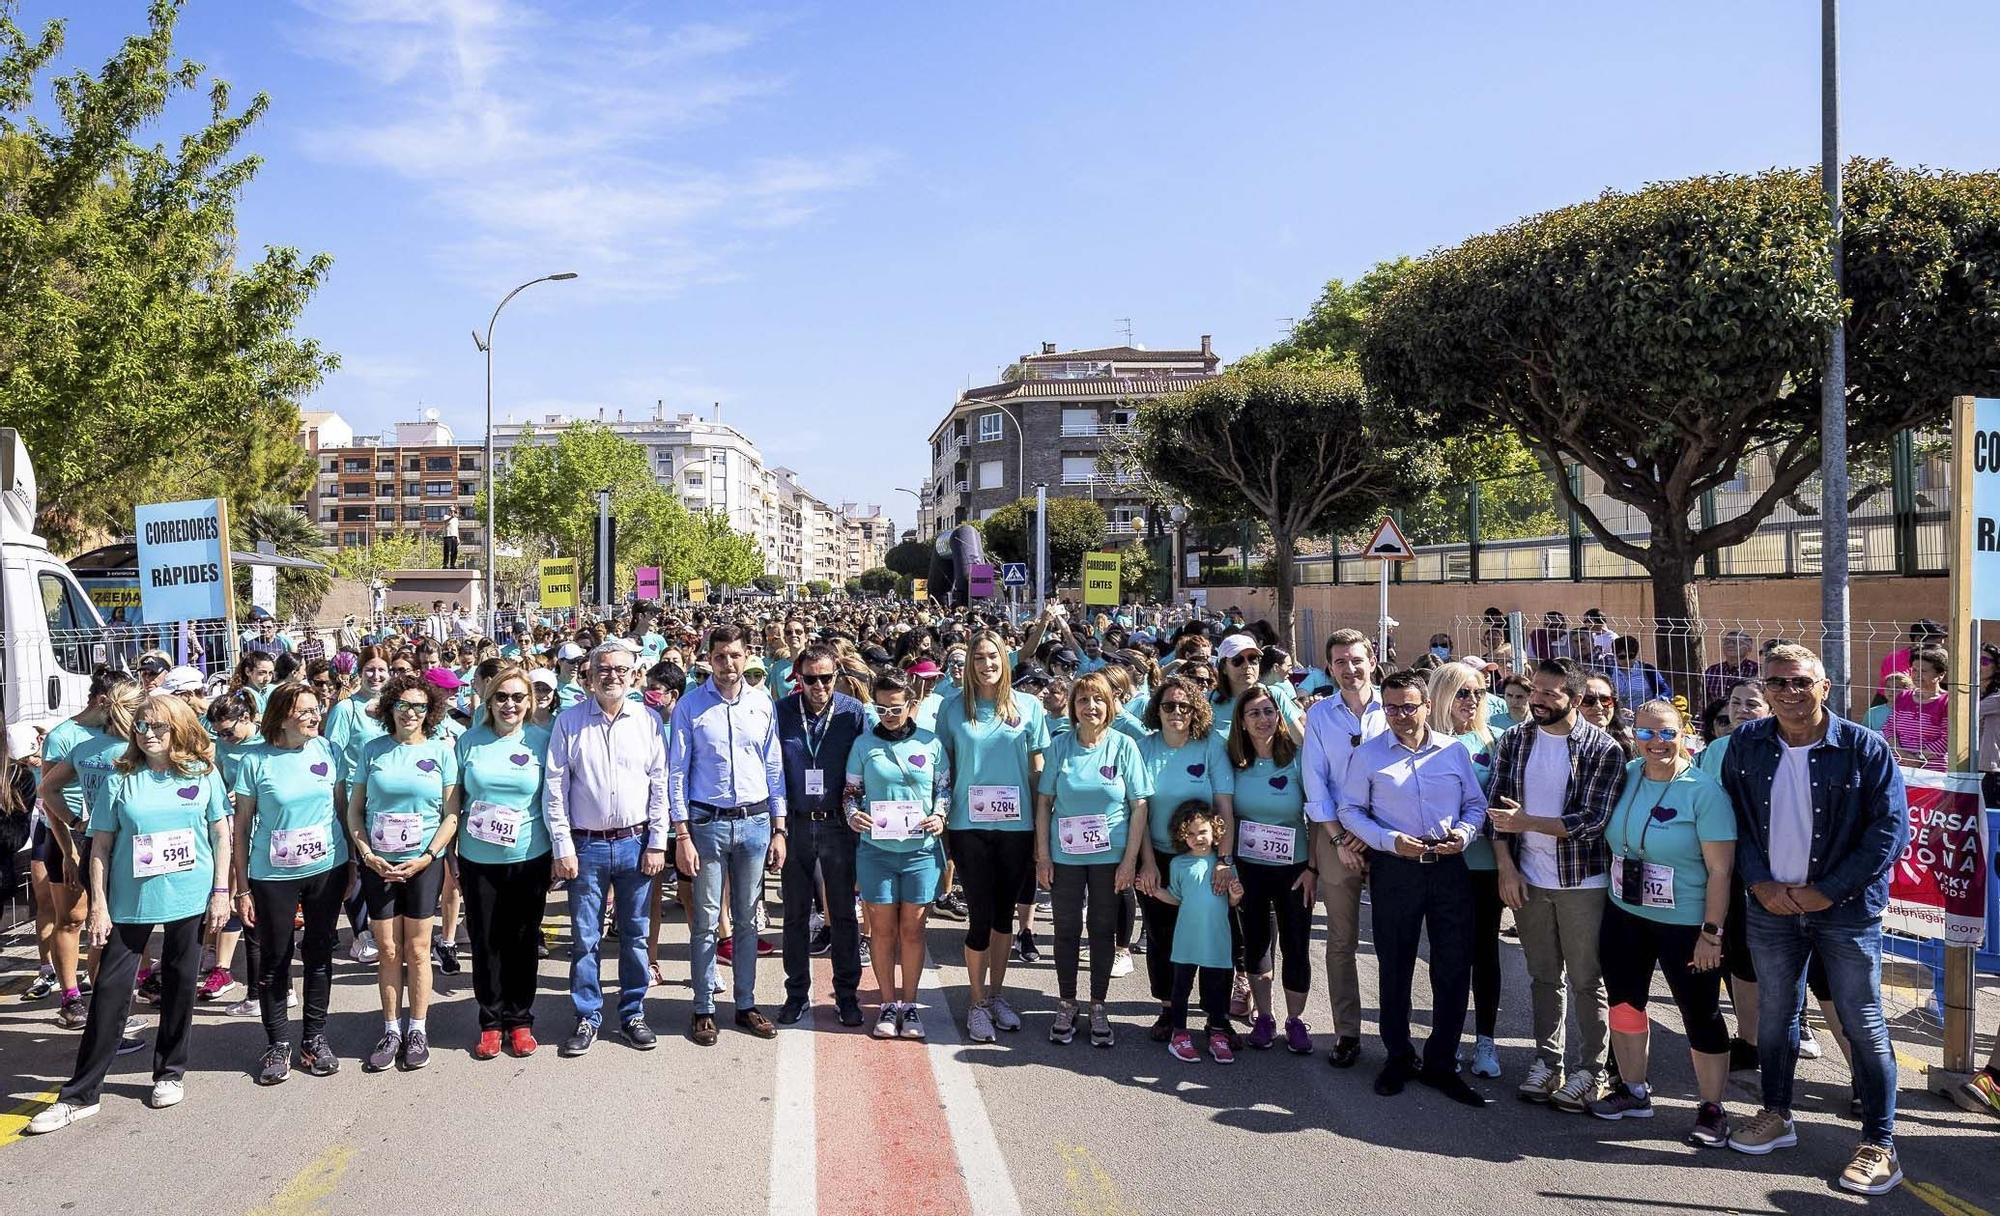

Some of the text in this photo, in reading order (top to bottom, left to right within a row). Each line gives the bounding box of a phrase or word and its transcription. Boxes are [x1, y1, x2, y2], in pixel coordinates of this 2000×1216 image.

[145, 516, 218, 545] CORREDORES
[543, 565, 573, 576] CORREDORES
[1087, 560, 1116, 571] CORREDORES
[151, 563, 219, 588] RÀPIDES
[548, 584, 571, 593] LENTES
[1090, 580, 1112, 589] LENTES
[991, 801, 1014, 812] 5284
[904, 815, 909, 828] 1
[1908, 806, 1979, 833] CURSA
[490, 820, 514, 835] 5431
[400, 829, 407, 841] 6
[1083, 830, 1101, 842] 525
[1909, 825, 1930, 846] DE
[163, 846, 189, 861] 5391
[296, 841, 322, 856] 2539
[1263, 840, 1288, 854] 3730
